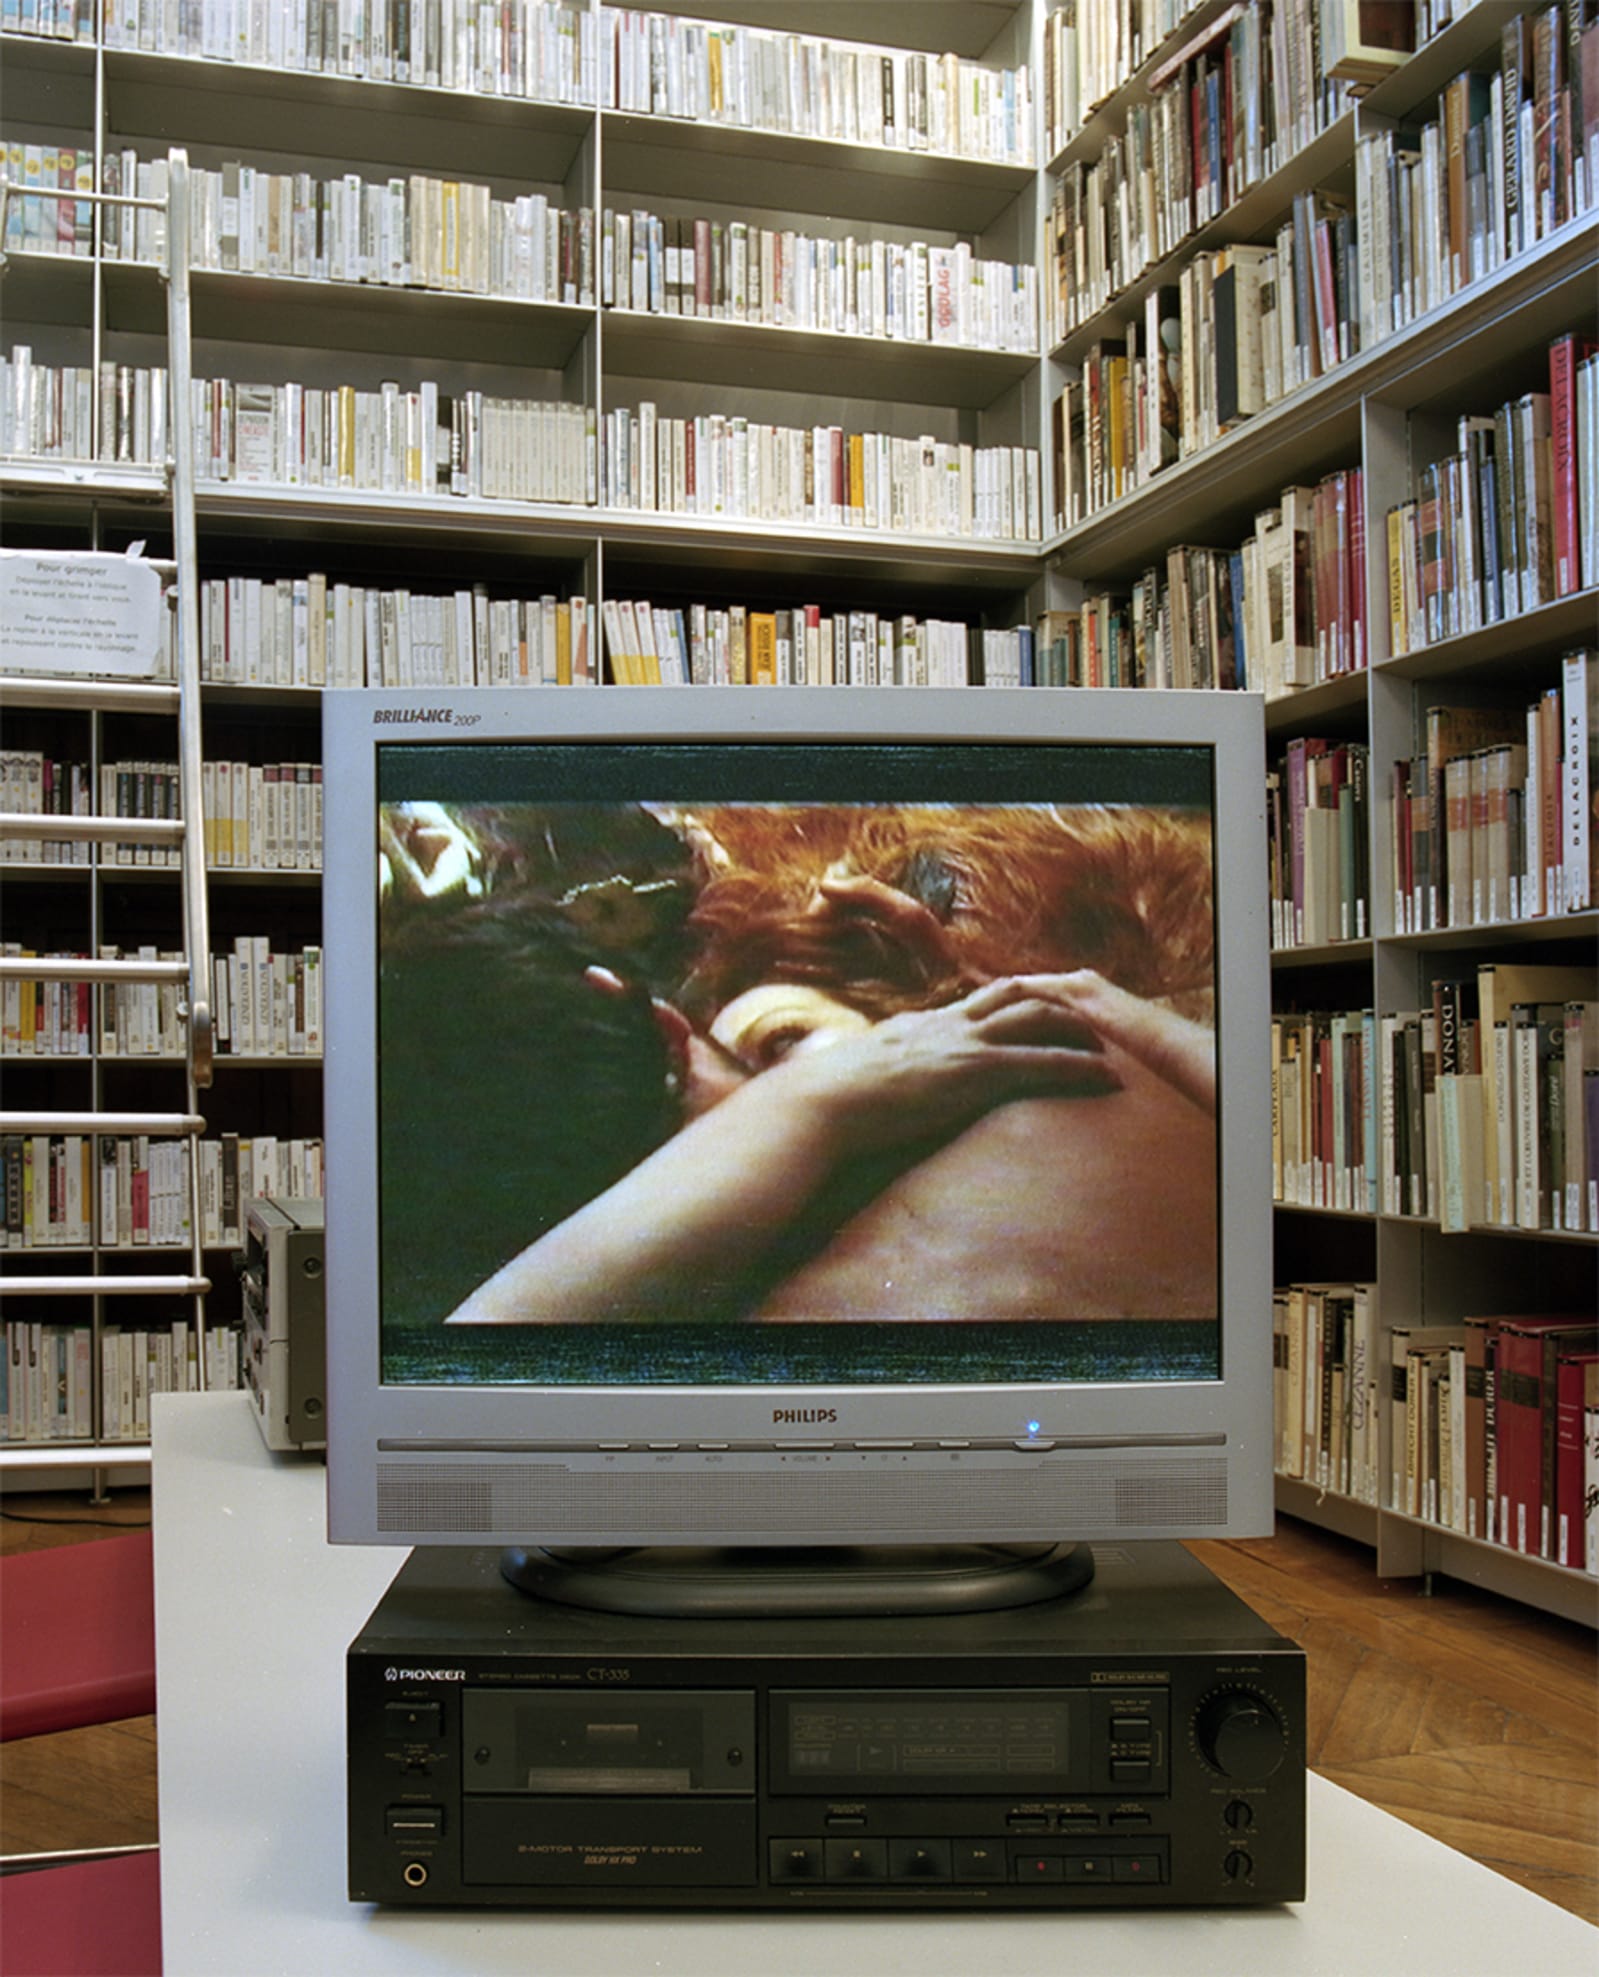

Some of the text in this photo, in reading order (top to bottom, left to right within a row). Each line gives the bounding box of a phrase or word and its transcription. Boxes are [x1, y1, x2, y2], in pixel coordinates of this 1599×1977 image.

[1504, 68, 1518, 209] GERARD DAVID
[1554, 347, 1570, 473] DELACROIX
[373, 707, 482, 727] BRILLIANCE 200P
[1570, 716, 1582, 847] DELACROIX
[773, 1409, 838, 1424] PHILIPS
[399, 1669, 466, 1681] PIONEER
